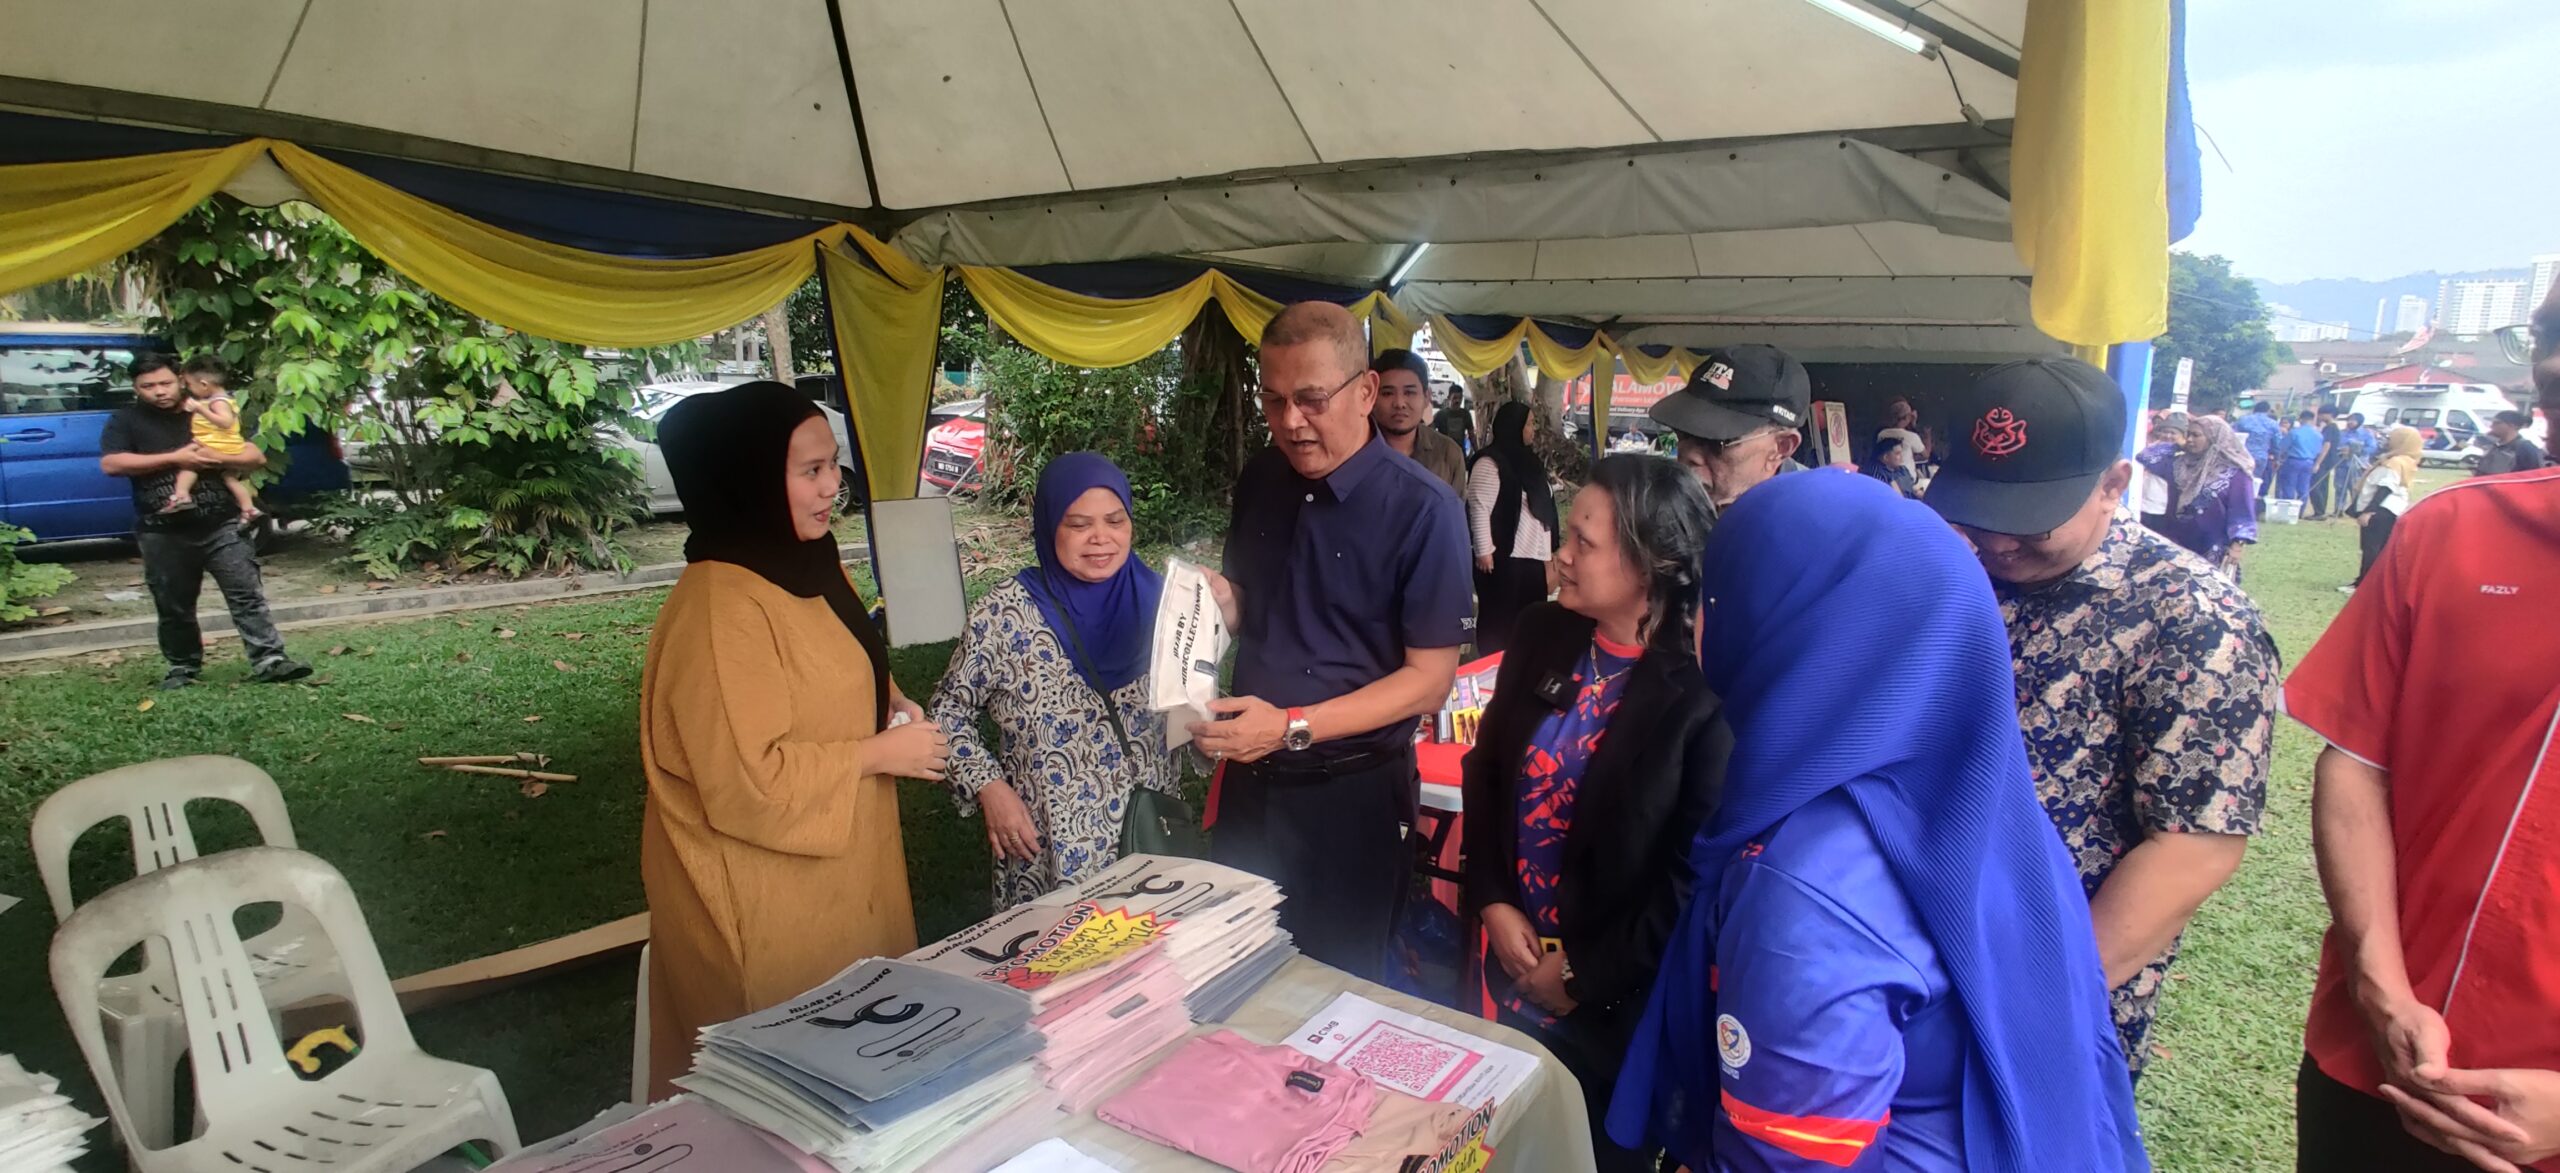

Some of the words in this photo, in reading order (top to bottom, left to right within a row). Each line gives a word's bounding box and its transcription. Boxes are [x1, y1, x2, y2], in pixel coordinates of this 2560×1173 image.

[2480, 585, 2519, 595] FAZLY
[1177, 612, 1187, 629] BY
[1173, 629, 1183, 659] HIJAB
[977, 918, 992, 930] BY
[982, 903, 1096, 977] PROMOTION
[789, 996, 825, 1014] HIJAB
[825, 988, 843, 1002] BY
[1318, 1020, 1340, 1037] CIMB
[1423, 1103, 1493, 1173] OMOTION
